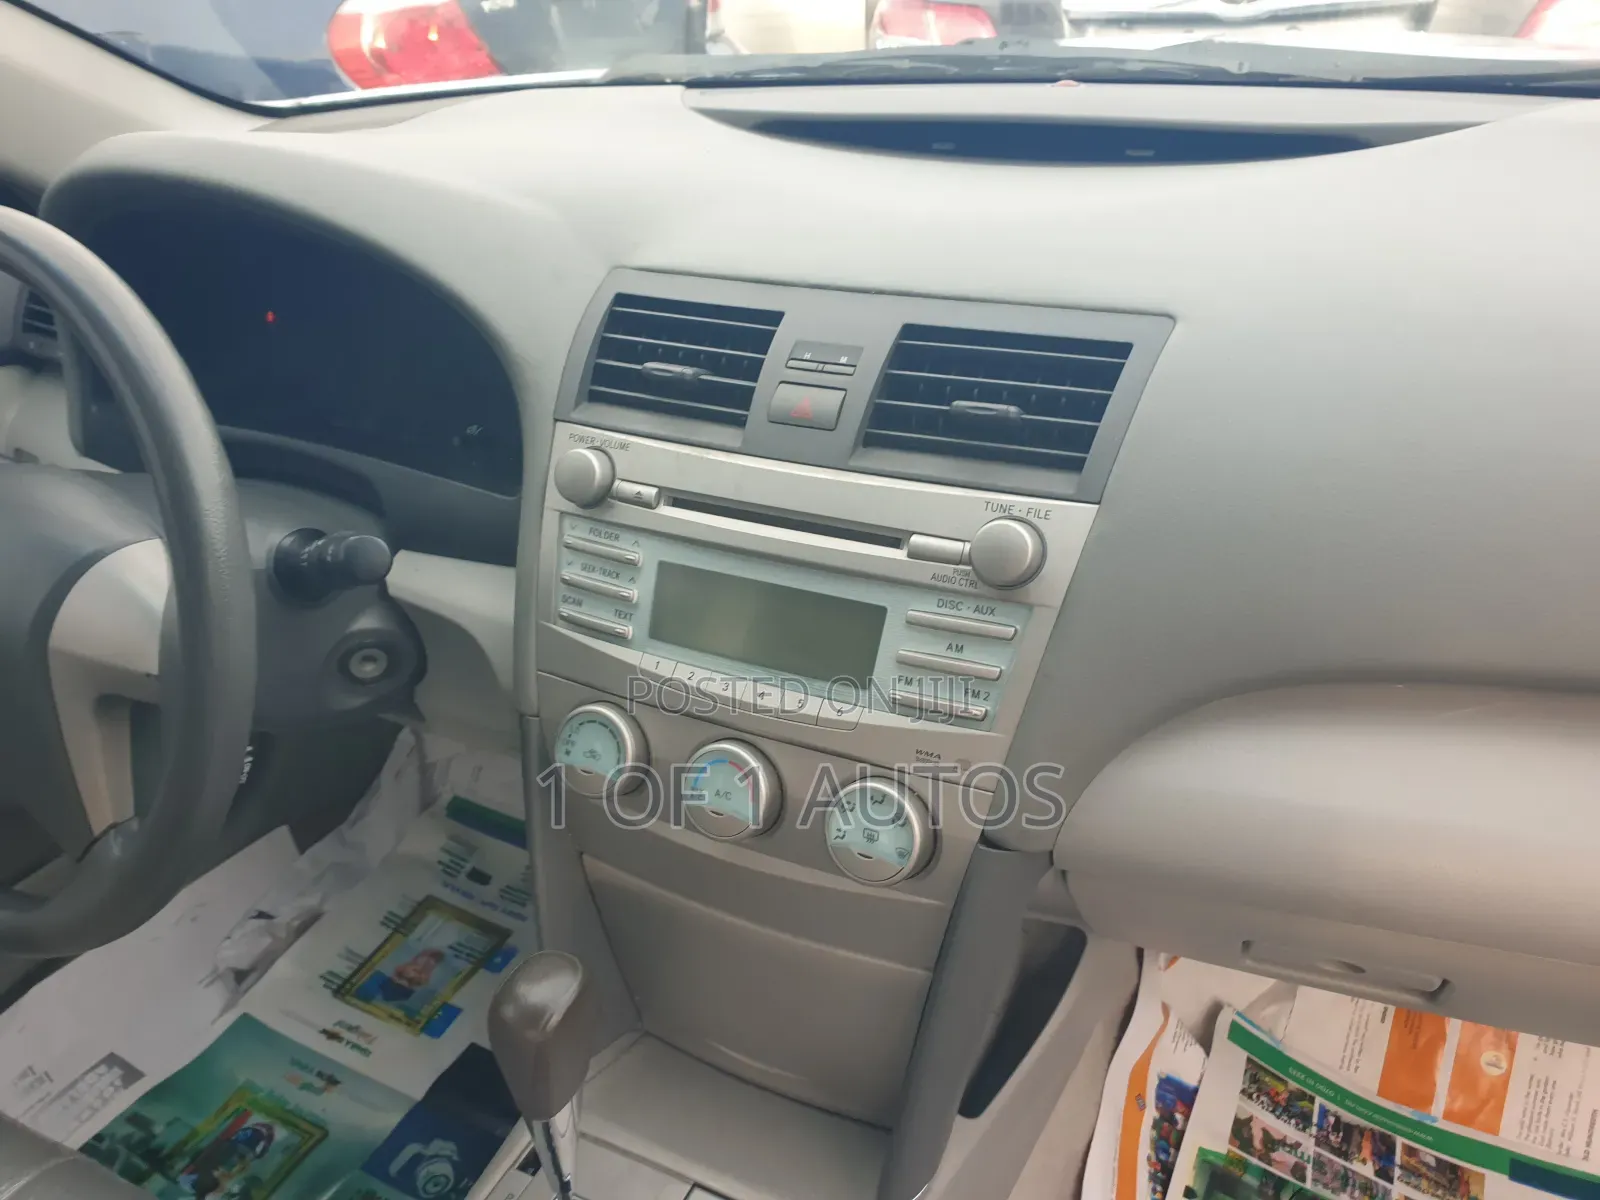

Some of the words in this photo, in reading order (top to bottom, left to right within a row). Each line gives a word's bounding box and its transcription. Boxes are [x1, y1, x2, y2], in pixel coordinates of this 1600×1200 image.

[984, 500, 1016, 516] TUNE
[1026, 507, 1053, 521] FILE
[588, 527, 621, 542] FOLDER
[930, 573, 957, 586] AUDIO
[561, 594, 583, 608] SCAN
[937, 598, 963, 612] DISC
[973, 605, 997, 617] AUX
[613, 608, 634, 622] TEXT
[946, 643, 964, 655] AM
[654, 660, 661, 671] 1
[686, 670, 697, 682] 2
[721, 681, 731, 693] 3
[835, 706, 845, 718] 6
[915, 748, 942, 761] WMA
[714, 789, 732, 801] A/C
